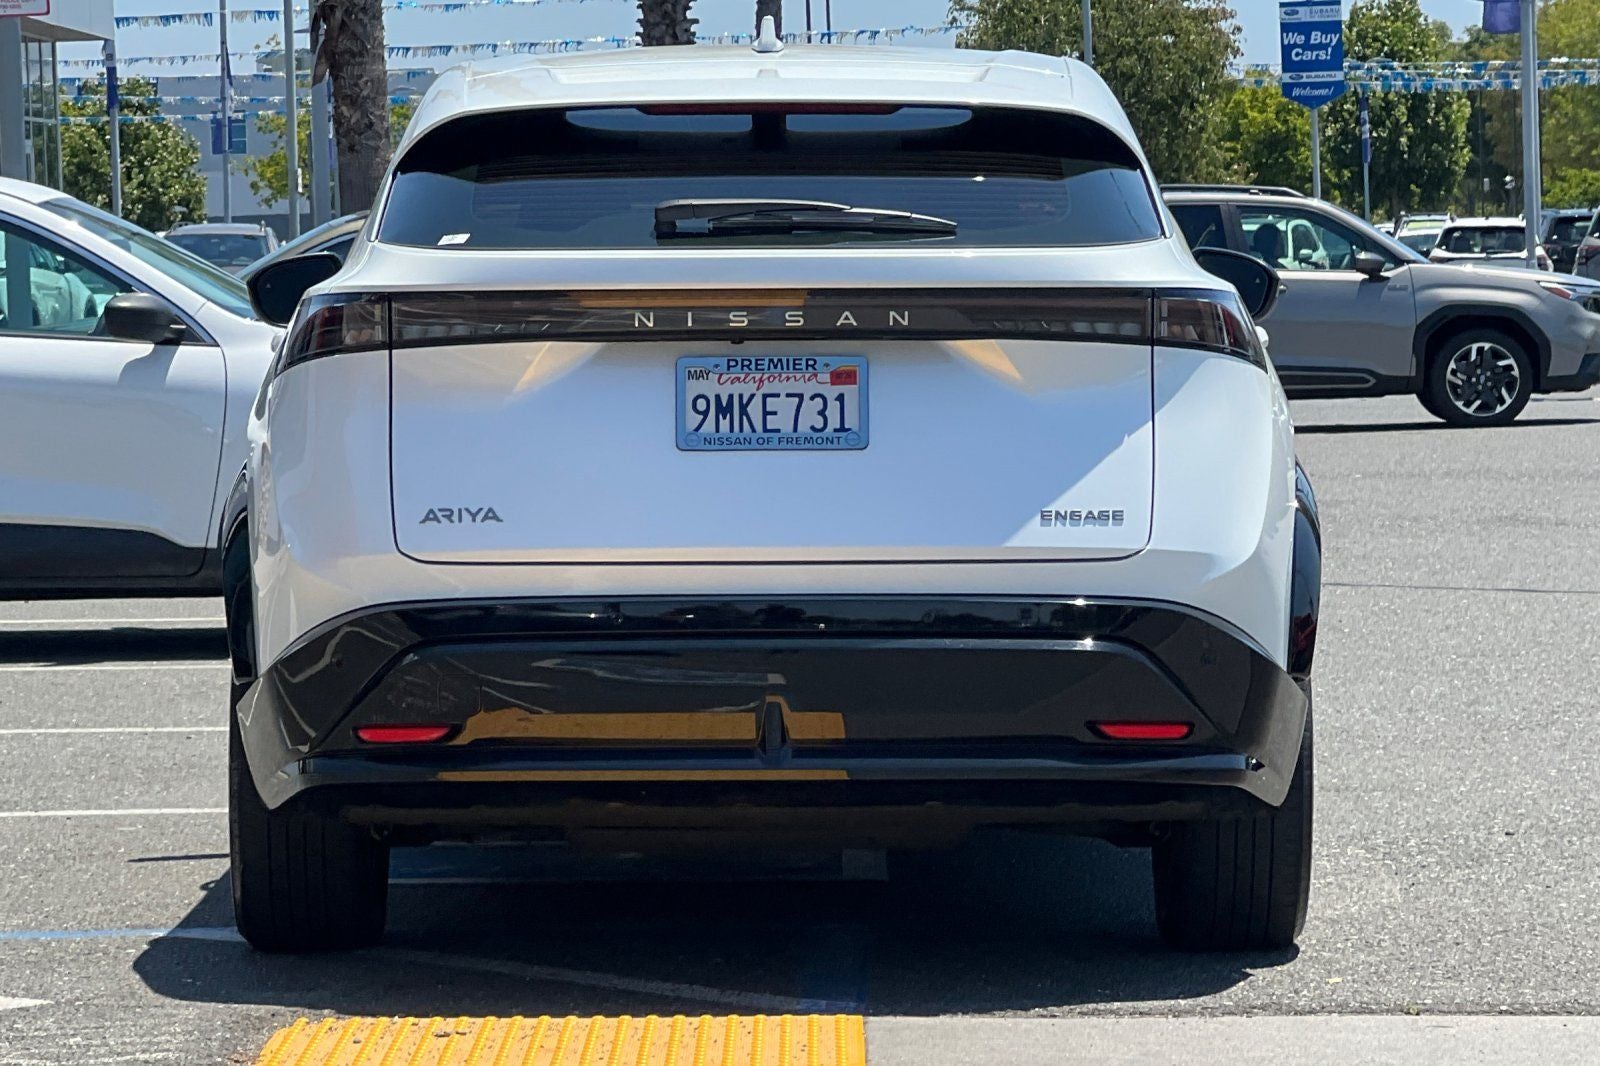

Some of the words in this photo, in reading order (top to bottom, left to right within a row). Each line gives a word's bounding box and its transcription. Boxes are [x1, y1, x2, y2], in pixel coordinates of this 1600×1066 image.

[1282, 32, 1305, 45] We
[1310, 31, 1340, 46] Buy
[1291, 47, 1333, 61] Cars!
[1292, 86, 1335, 97] Welcome!
[634, 311, 909, 327] NISSAN
[726, 358, 818, 371] PREMIER
[687, 369, 711, 381] MAY
[717, 373, 830, 391] California
[691, 393, 852, 433] 9MKE731
[703, 437, 752, 446] NISSAN
[756, 437, 773, 446] OF
[778, 437, 842, 446] FREMONT
[419, 507, 504, 524] ARIYA
[1040, 510, 1124, 521] ENGAGE
